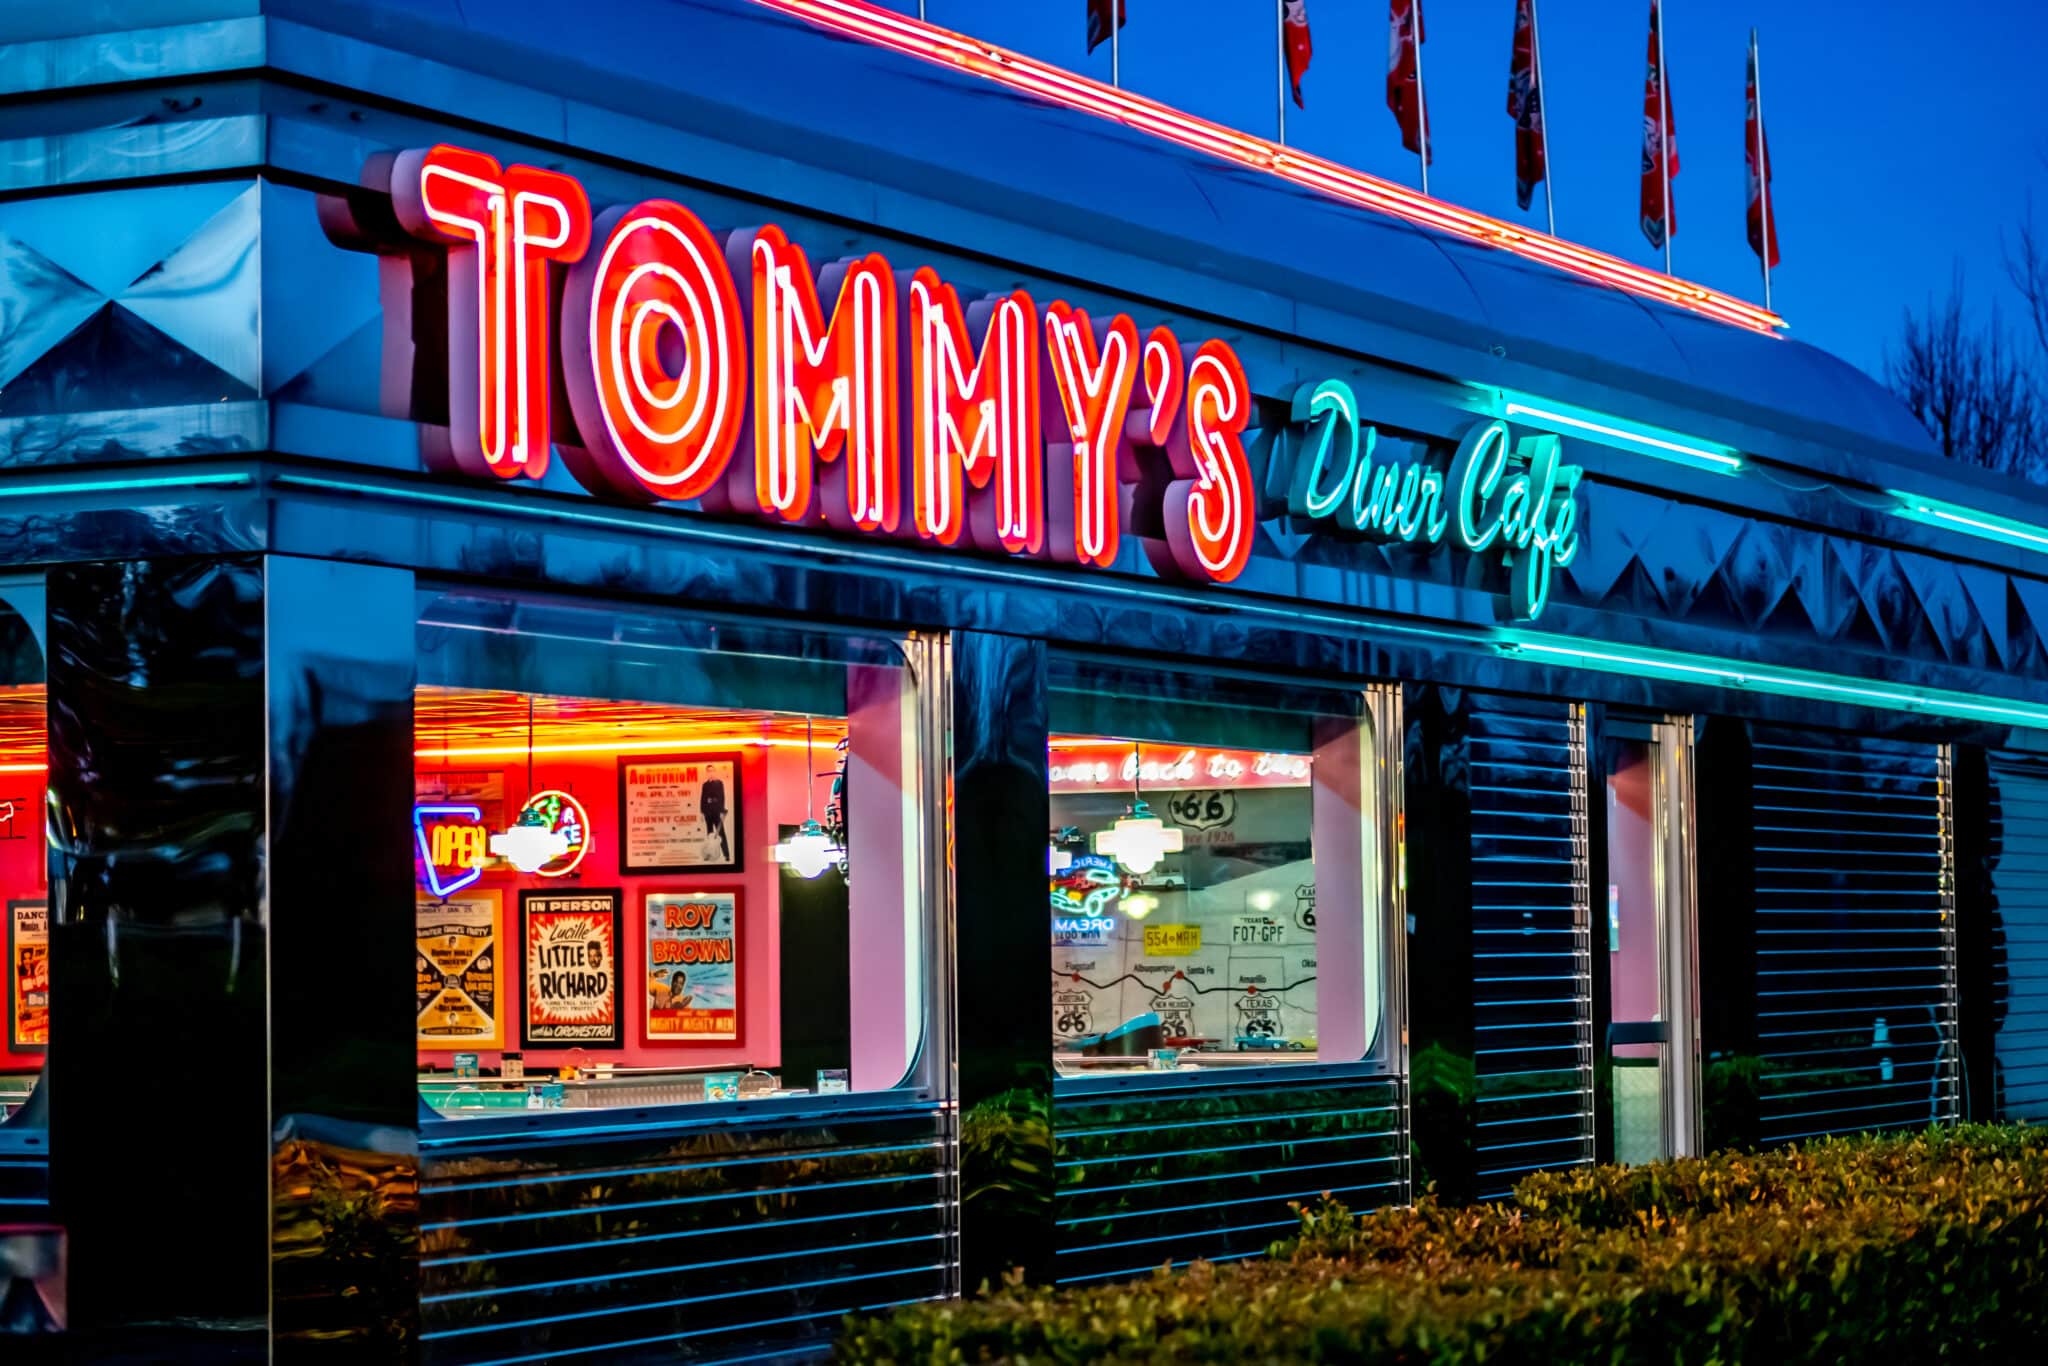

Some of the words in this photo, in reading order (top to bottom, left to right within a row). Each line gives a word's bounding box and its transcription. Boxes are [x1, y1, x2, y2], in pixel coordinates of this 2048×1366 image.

[416, 143, 1256, 583] TOMMY'S
[1304, 378, 1448, 542] Diner
[630, 767, 698, 784] AUDITORIUM
[1182, 792, 1226, 821] 66
[632, 815, 671, 824] JOHNNY
[432, 825, 486, 867] OPEN
[530, 902, 546, 912] IN
[549, 900, 611, 912] PERSON
[664, 903, 717, 929] ROY
[550, 921, 590, 941] Lucille
[538, 944, 585, 969] LITTLE
[651, 938, 732, 964] BROWN
[539, 971, 608, 999] RICHARD
[1239, 975, 1267, 984] Amarillo
[1246, 1000, 1273, 1008] TEXAS
[1058, 1013, 1086, 1033] 66
